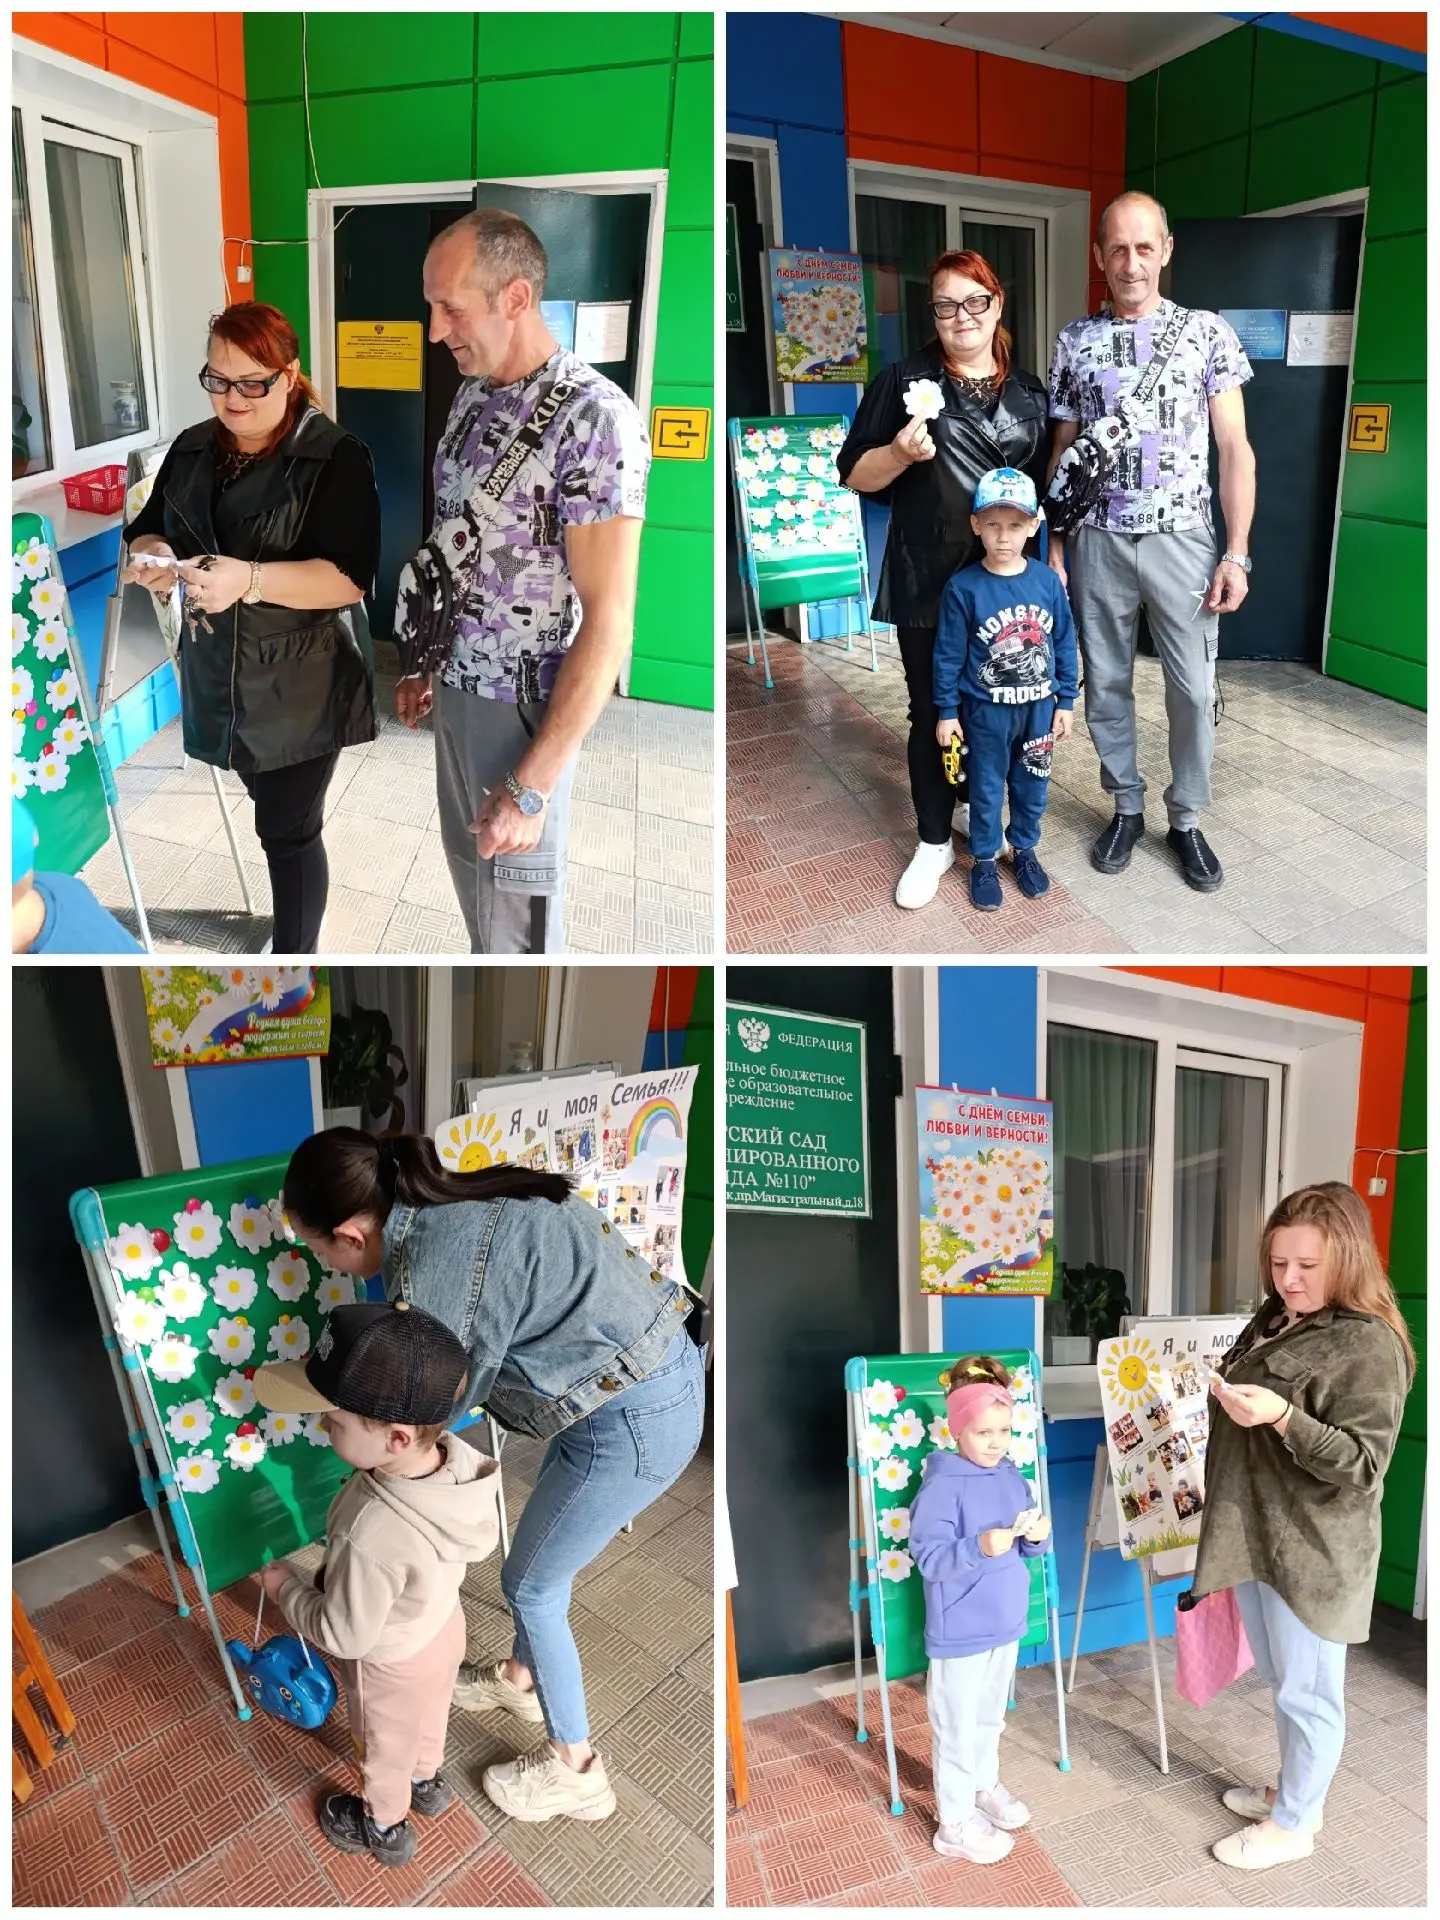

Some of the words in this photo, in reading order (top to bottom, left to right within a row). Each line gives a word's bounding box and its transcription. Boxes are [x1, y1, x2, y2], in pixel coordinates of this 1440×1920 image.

[1138, 514, 1153, 523] 88
[989, 680, 1052, 704] TRUCK
[247, 1011, 280, 1030] Родная
[281, 1017, 302, 1029] душа
[302, 1014, 326, 1026] всегда
[243, 1032, 290, 1044] поддержит
[777, 1032, 853, 1053] ФЕДЕРАЦИЯ
[770, 1063, 845, 1085] бюджетное
[739, 1077, 854, 1101] образовательное
[509, 1108, 522, 1137] Я
[537, 1107, 548, 1128] и
[564, 1094, 598, 1118] моя
[611, 1071, 690, 1107] Семья!!!
[958, 1105, 965, 1116] С
[968, 1104, 1004, 1121] ДНЁМ
[1006, 1110, 1049, 1127] СЕМЬИ,
[726, 1126, 783, 1146] СКИЙ
[789, 1132, 828, 1153] САД
[926, 1120, 970, 1136] ЛЮБВИ
[974, 1125, 982, 1137] И
[986, 1125, 1048, 1144] ВЕРНОСТИ!
[1163, 1338, 1173, 1355] Я
[1187, 1340, 1196, 1352] и
